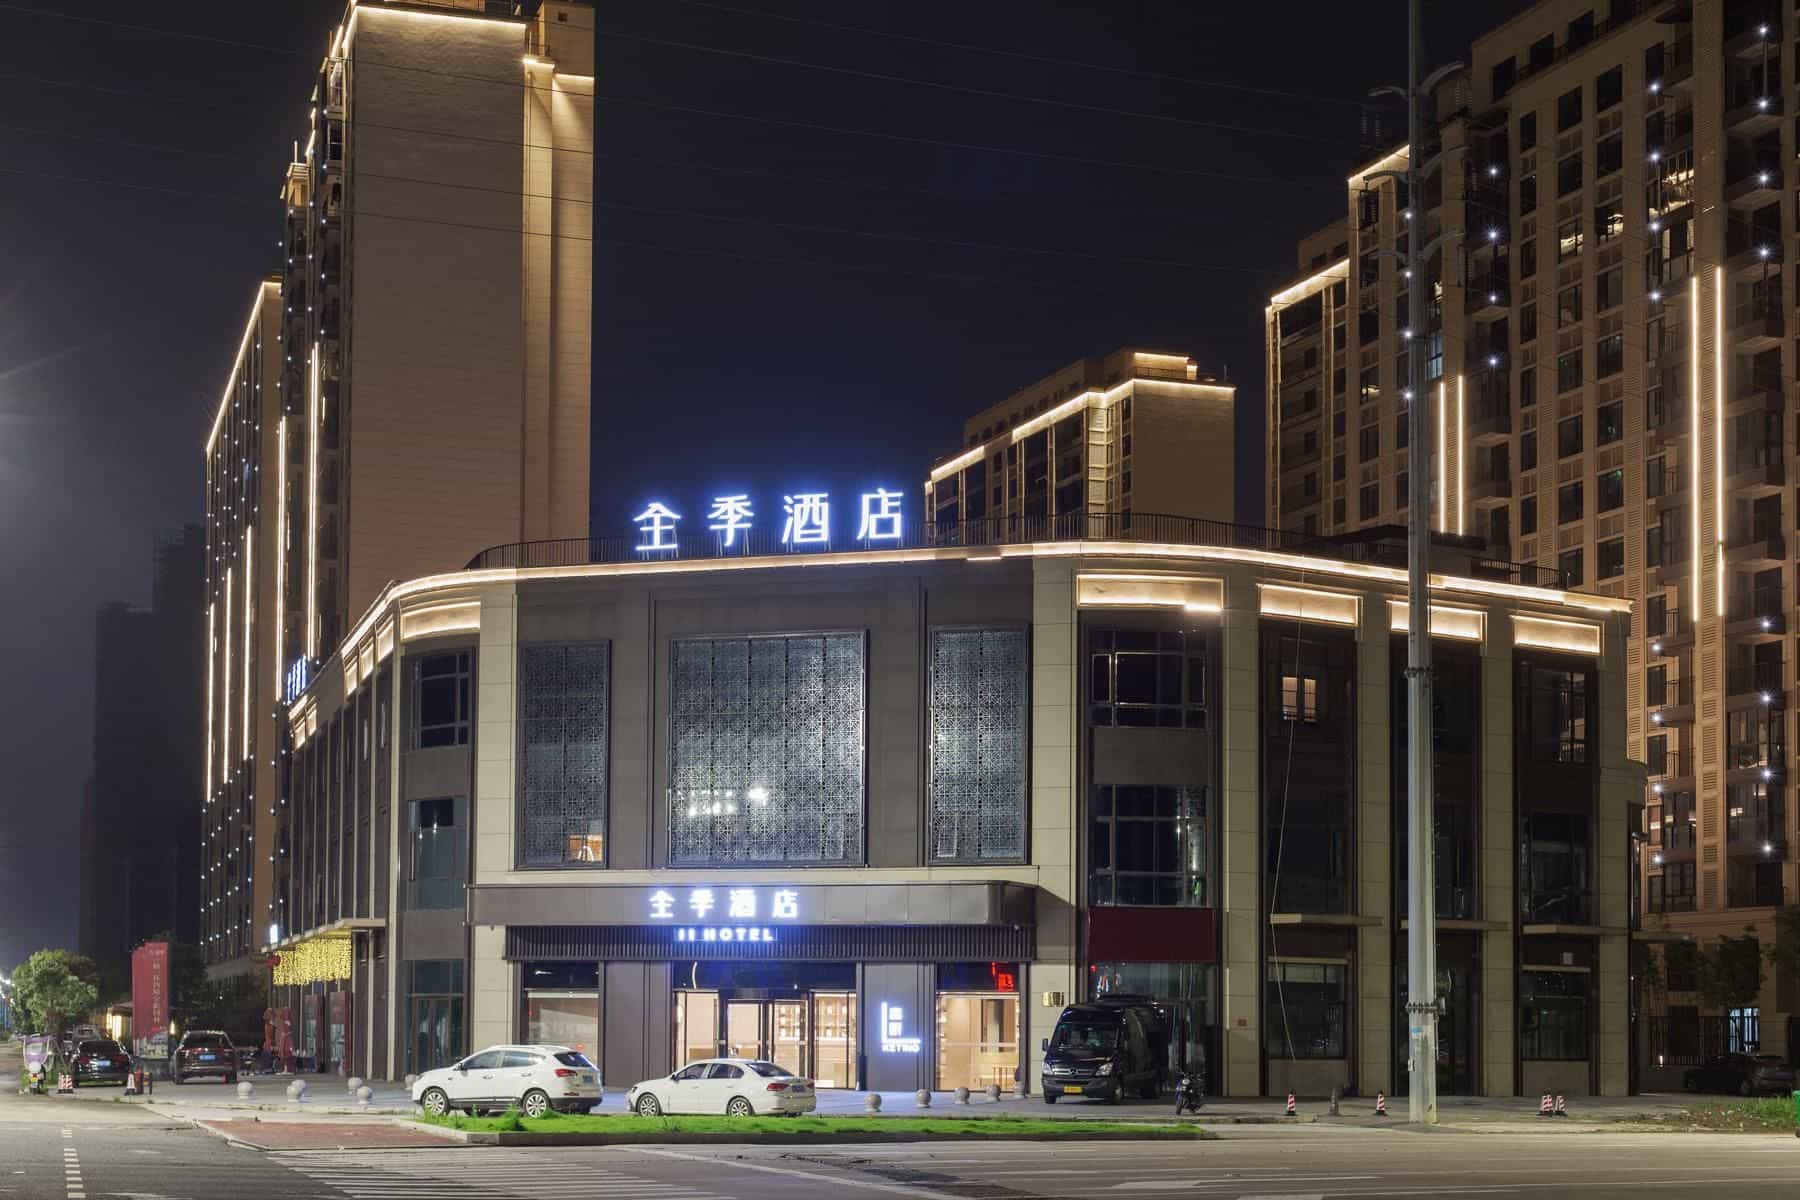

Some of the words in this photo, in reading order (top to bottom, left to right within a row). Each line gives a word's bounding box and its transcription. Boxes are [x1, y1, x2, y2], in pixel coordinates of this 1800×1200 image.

[633, 488, 904, 551] 全季酒店
[649, 889, 799, 918] 全季酒店
[703, 927, 774, 942] HOTEL
